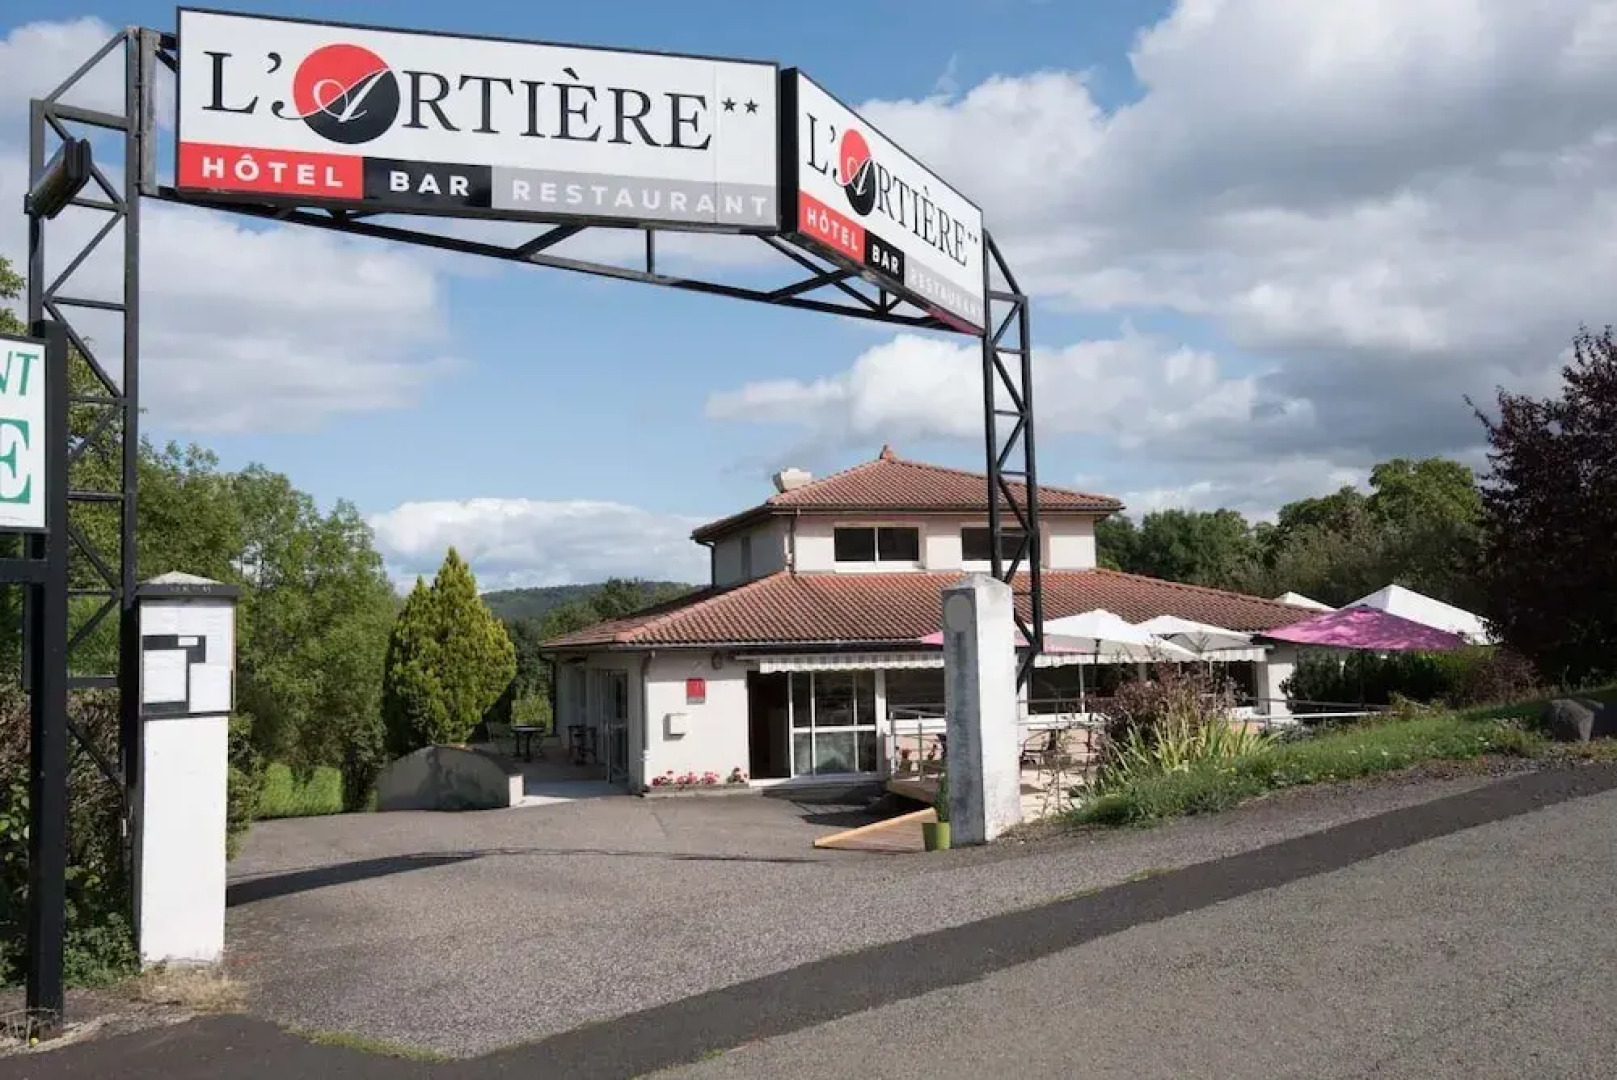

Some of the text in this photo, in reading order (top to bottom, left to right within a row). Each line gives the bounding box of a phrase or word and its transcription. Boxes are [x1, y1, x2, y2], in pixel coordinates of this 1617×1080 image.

[202, 155, 768, 217] HÔTEL BAR RESTAURANT
[806, 207, 858, 252] HÔTEL
[872, 245, 900, 275] BAR
